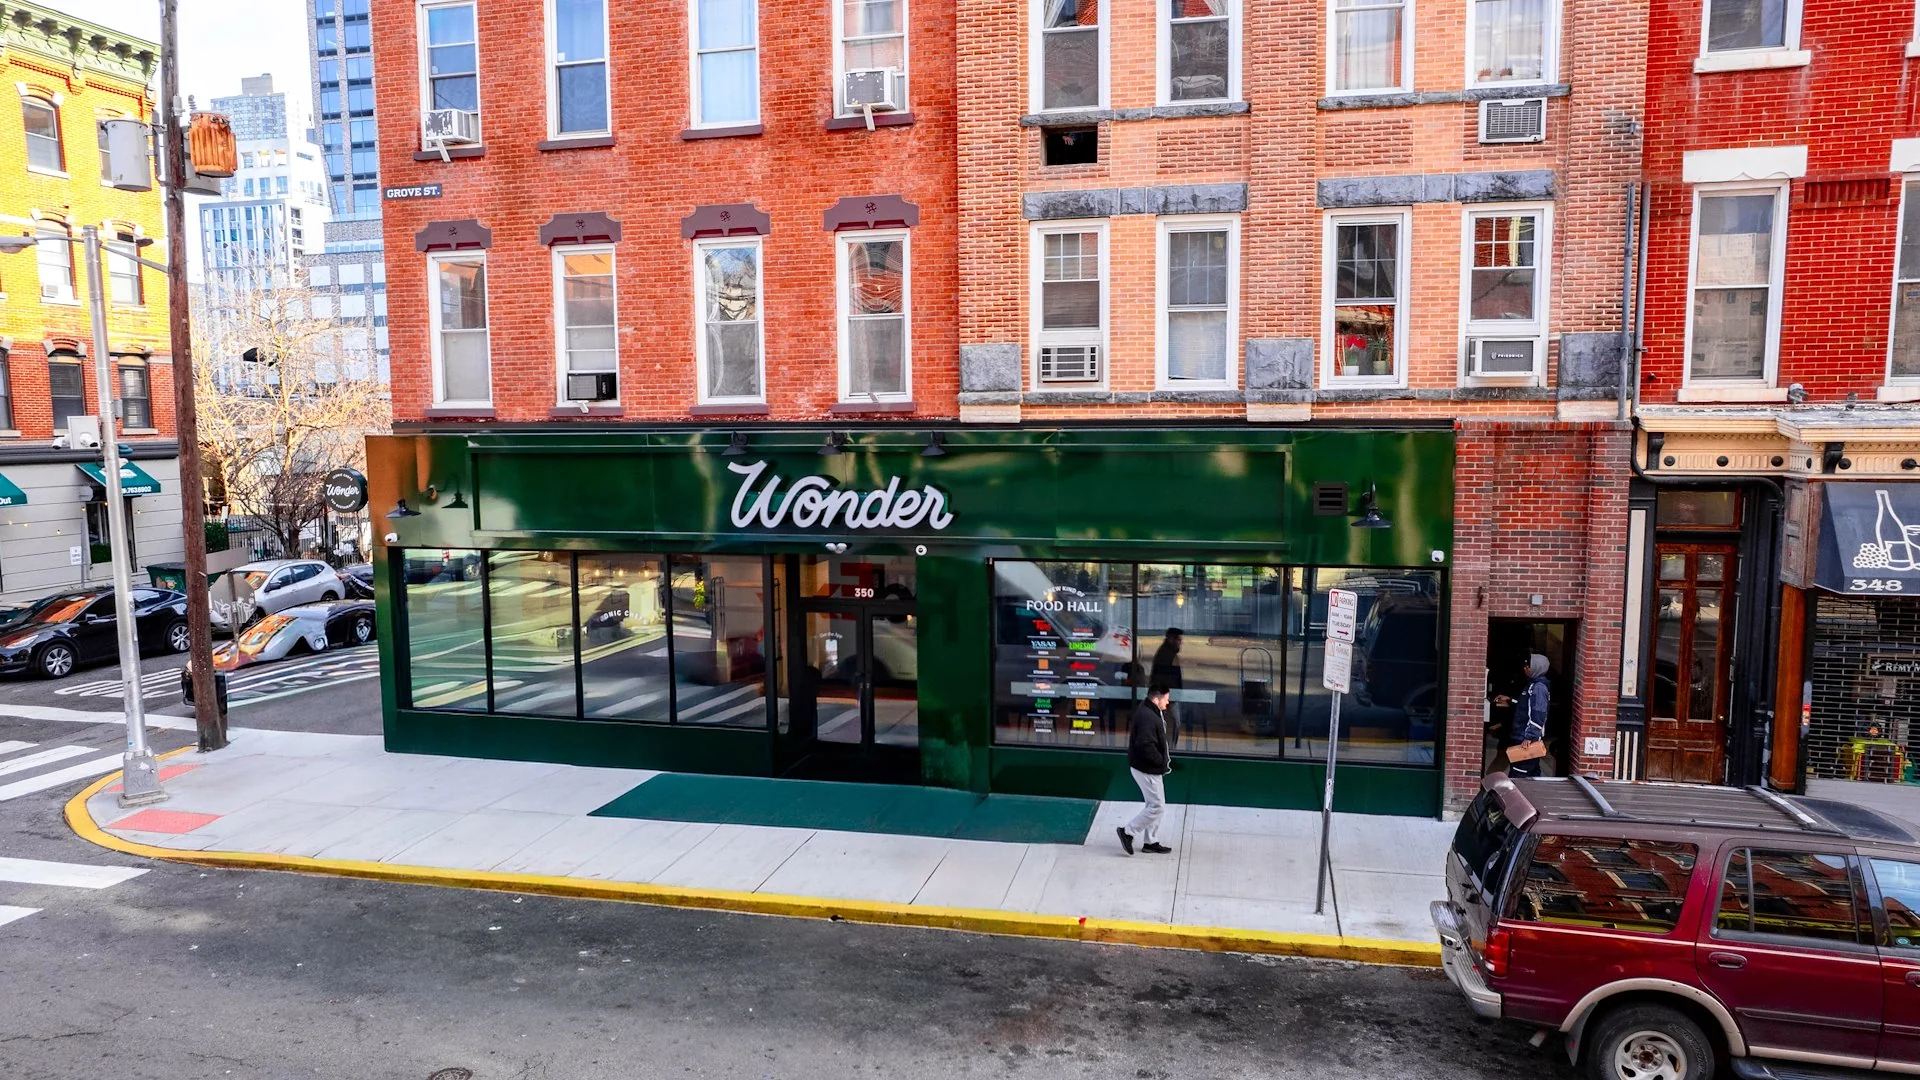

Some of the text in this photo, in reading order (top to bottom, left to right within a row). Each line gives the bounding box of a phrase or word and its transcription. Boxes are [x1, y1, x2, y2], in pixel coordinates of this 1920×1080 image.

[387, 186, 440, 198] GROVE ST.
[326, 484, 359, 497] Wonder
[727, 459, 954, 530] Wonder
[1062, 585, 1077, 594] KIND
[1850, 578, 1903, 592] 348
[854, 587, 875, 598] 350
[1026, 600, 1102, 613] FOOD HALL
[1332, 620, 1351, 628] TUESDAY
